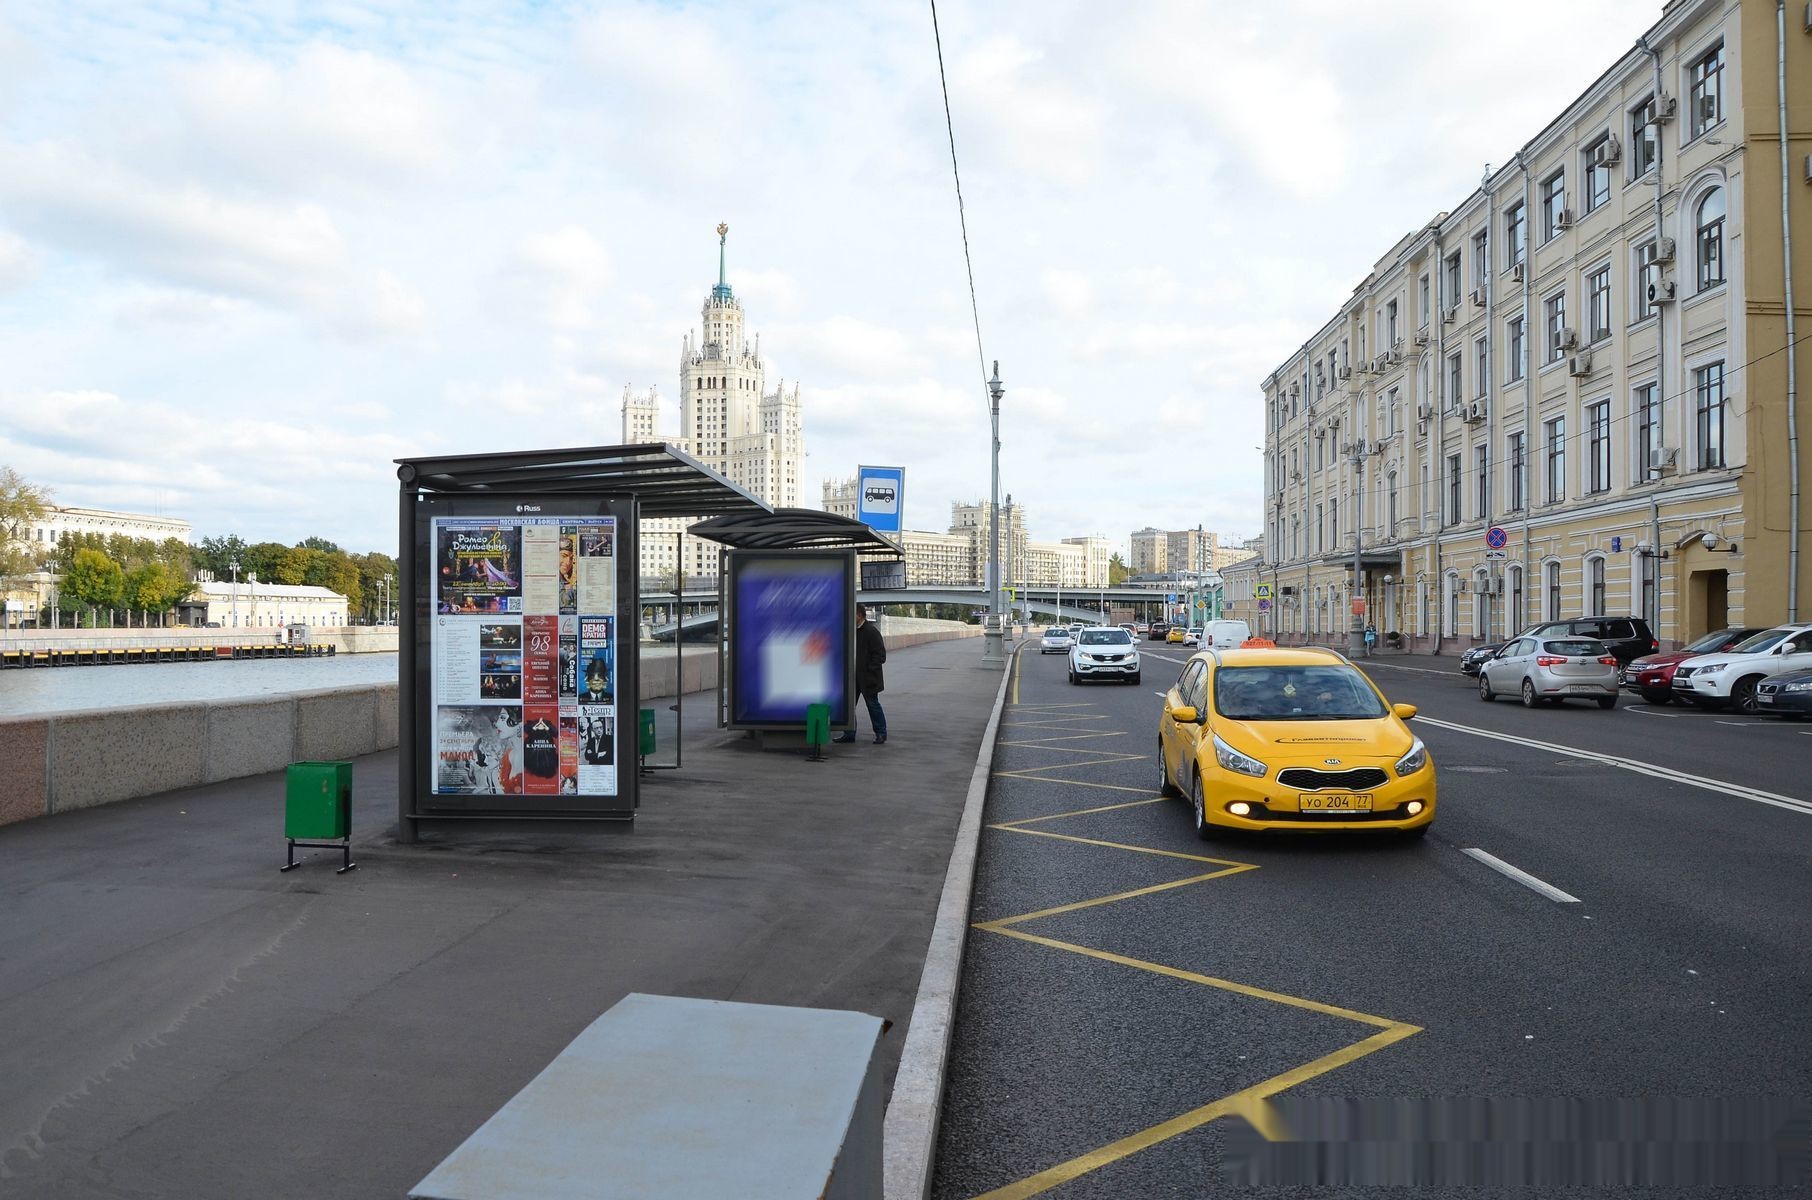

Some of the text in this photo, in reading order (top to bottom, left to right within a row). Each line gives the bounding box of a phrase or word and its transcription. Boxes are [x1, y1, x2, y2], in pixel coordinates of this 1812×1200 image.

[458, 534, 488, 543] Ромео
[530, 635, 551, 652] 98
[1327, 796, 1349, 808] 204
[1357, 795, 1368, 805] 77
